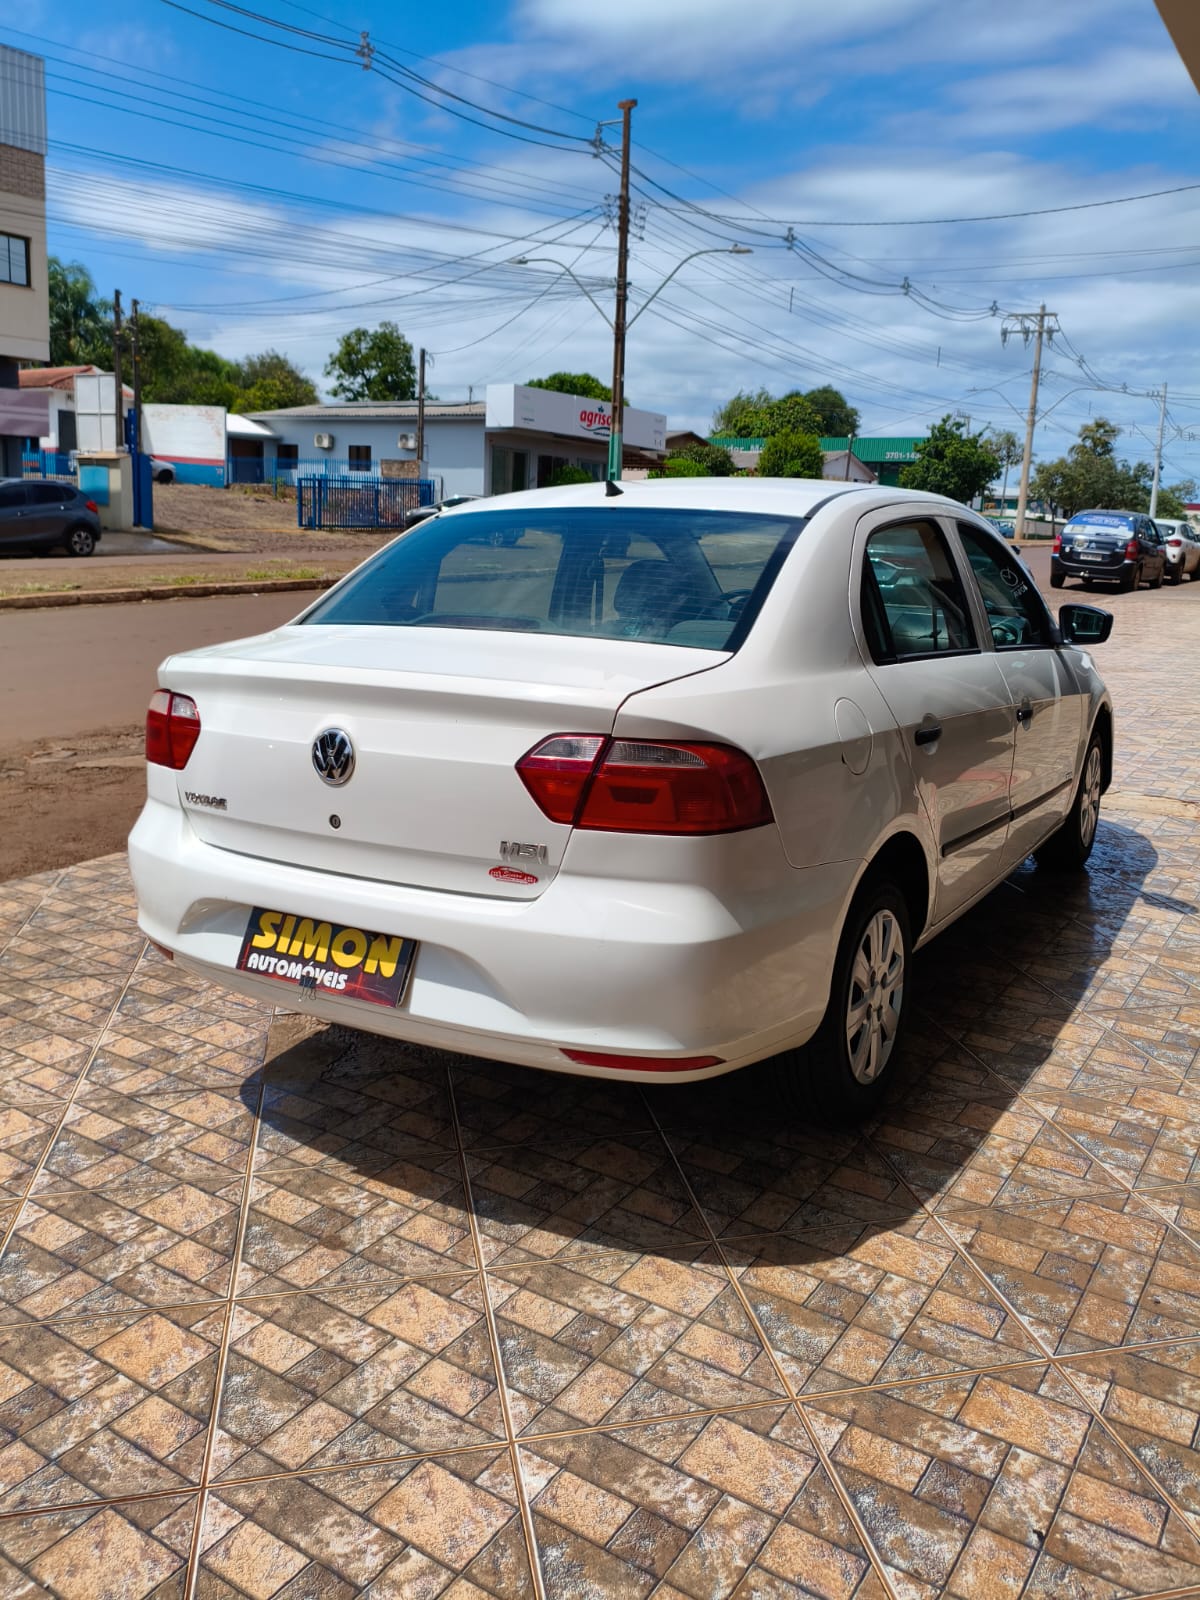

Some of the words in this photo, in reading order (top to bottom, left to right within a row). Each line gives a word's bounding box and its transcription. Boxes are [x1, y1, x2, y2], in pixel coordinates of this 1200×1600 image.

[500, 841, 548, 860] MSI
[252, 911, 403, 978] SIMON
[247, 952, 348, 990] AUTOMÓVEIS
